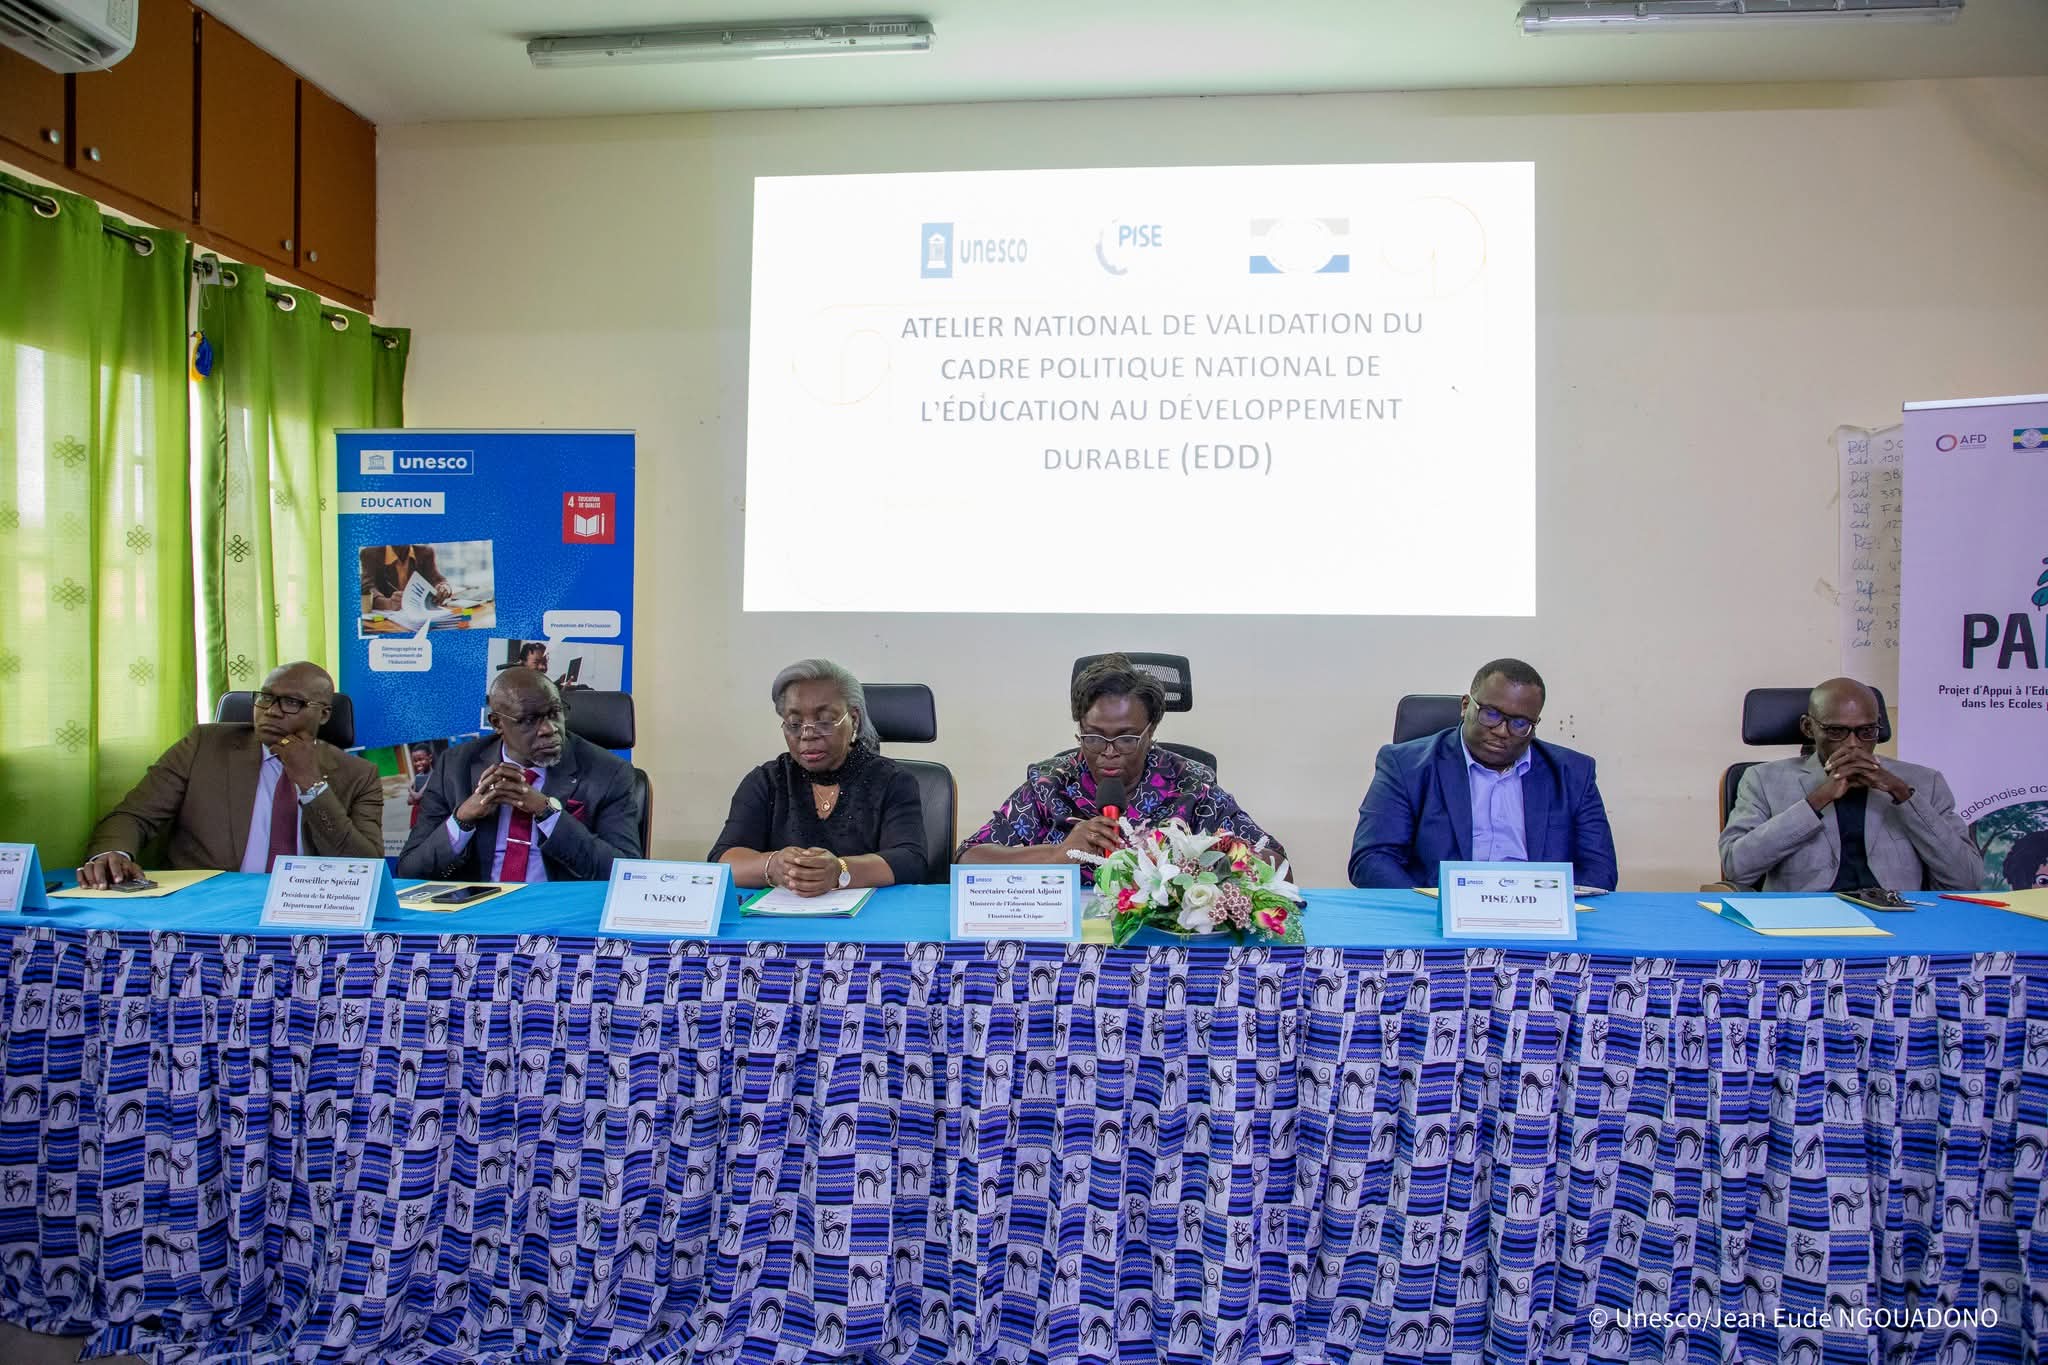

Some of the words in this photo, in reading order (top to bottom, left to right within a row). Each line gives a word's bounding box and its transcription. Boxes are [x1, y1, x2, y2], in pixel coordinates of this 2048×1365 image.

[1119, 225, 1162, 247] PISE
[960, 236, 1028, 265] unesco
[901, 316, 1004, 339] ATELIER
[1013, 314, 1152, 338] NATIONAL
[1162, 314, 1197, 336] DE
[1205, 312, 1374, 336] VALIDATION
[1383, 312, 1424, 334] DU
[941, 357, 1031, 380] CADRE
[1040, 356, 1185, 381] POLITIQUE
[1194, 355, 1337, 378] NATIONAL
[1346, 354, 1381, 377] DE
[1109, 399, 1149, 421] AU
[1158, 394, 1404, 421] DÉVELOPPEMENT
[1960, 434, 1987, 444] AFD
[400, 455, 468, 469] unesco
[1043, 447, 1171, 471] DURABLE
[1181, 442, 1273, 476] (EDD)
[360, 497, 432, 509] EDUCATION
[568, 496, 575, 508] 4
[1963, 613, 2048, 669] PA
[1939, 685, 1970, 697] Projet
[1973, 685, 2013, 698] d'Appui
[2016, 685, 2022, 696] à
[1961, 698, 1986, 709] dans
[1989, 698, 2005, 709] les
[2008, 698, 2043, 709] Ecoles
[1960, 787, 2026, 820] gabonaise
[289, 875, 330, 885] Conseiller
[644, 893, 687, 904] UNESCO
[969, 887, 1006, 895] Secrétaire
[1007, 887, 1036, 895] Général
[1036, 887, 1062, 896] Adjoint
